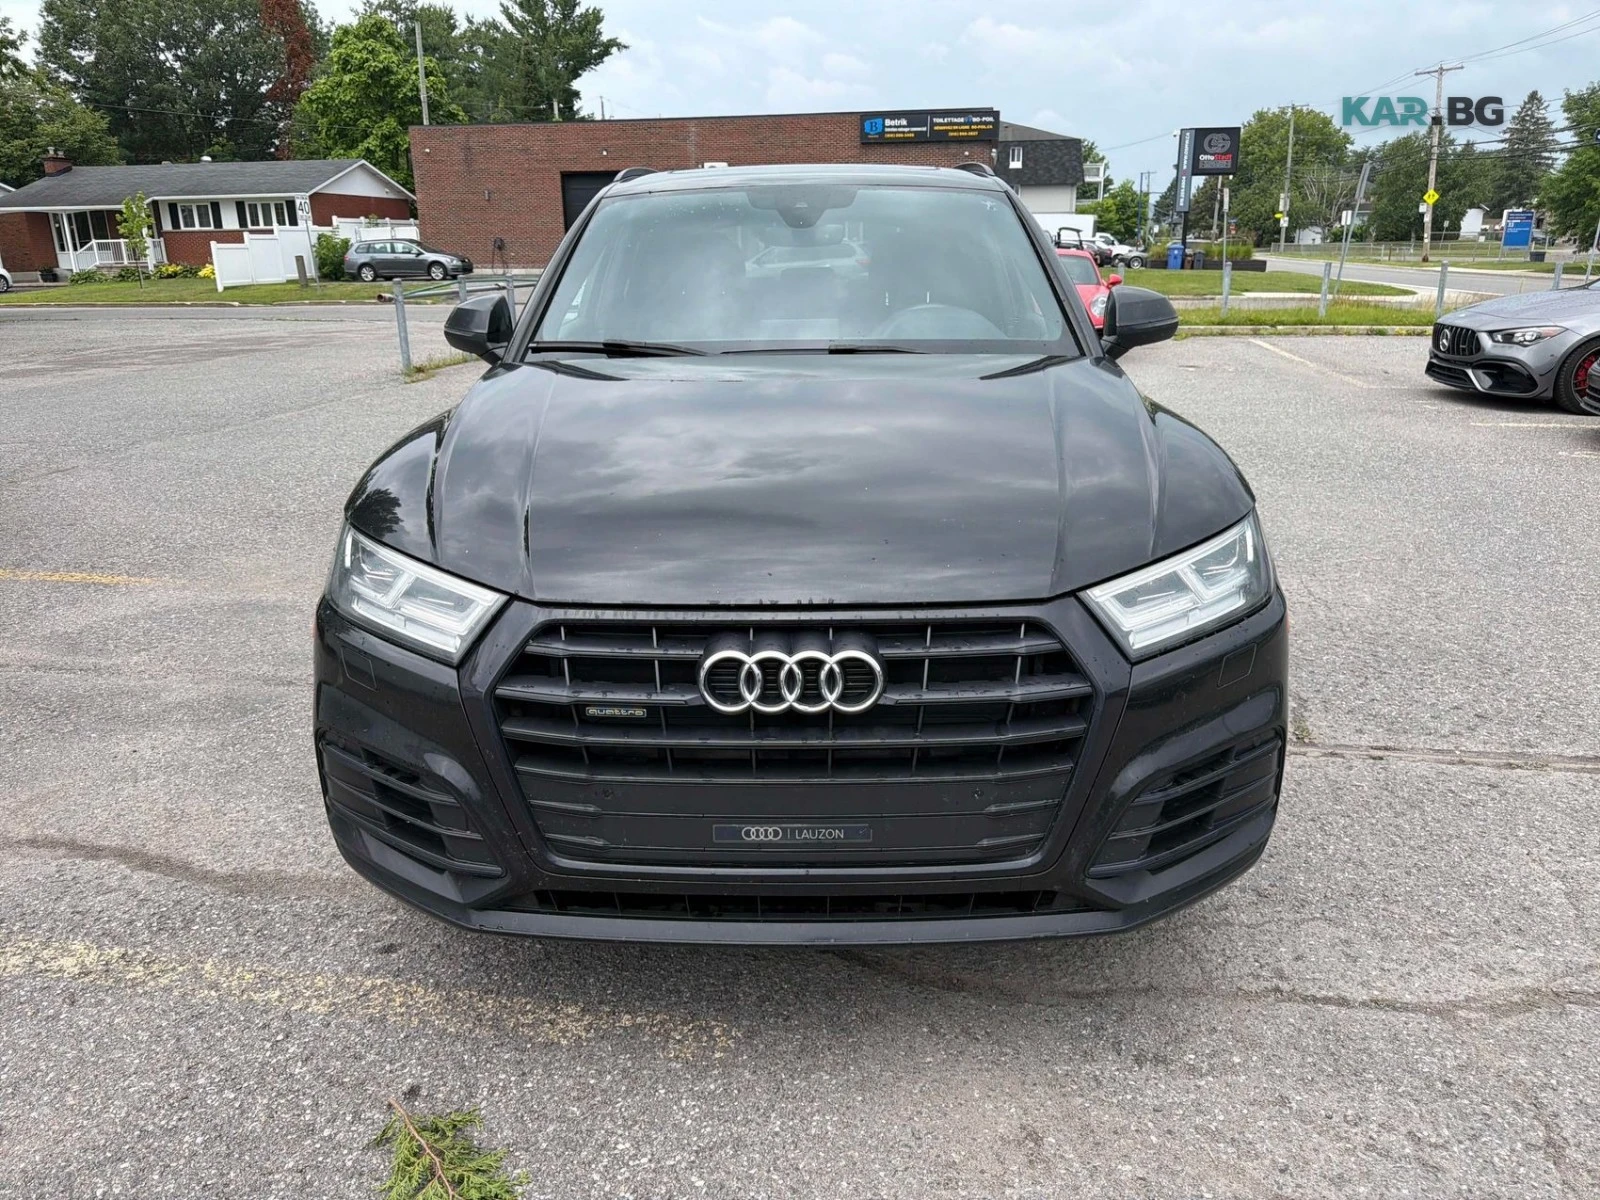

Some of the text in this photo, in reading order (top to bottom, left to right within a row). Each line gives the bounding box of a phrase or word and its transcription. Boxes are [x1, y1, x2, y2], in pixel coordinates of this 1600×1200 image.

[884, 118, 908, 126] Betrik
[298, 201, 310, 215] 40
[795, 829, 844, 840] LAUZON
